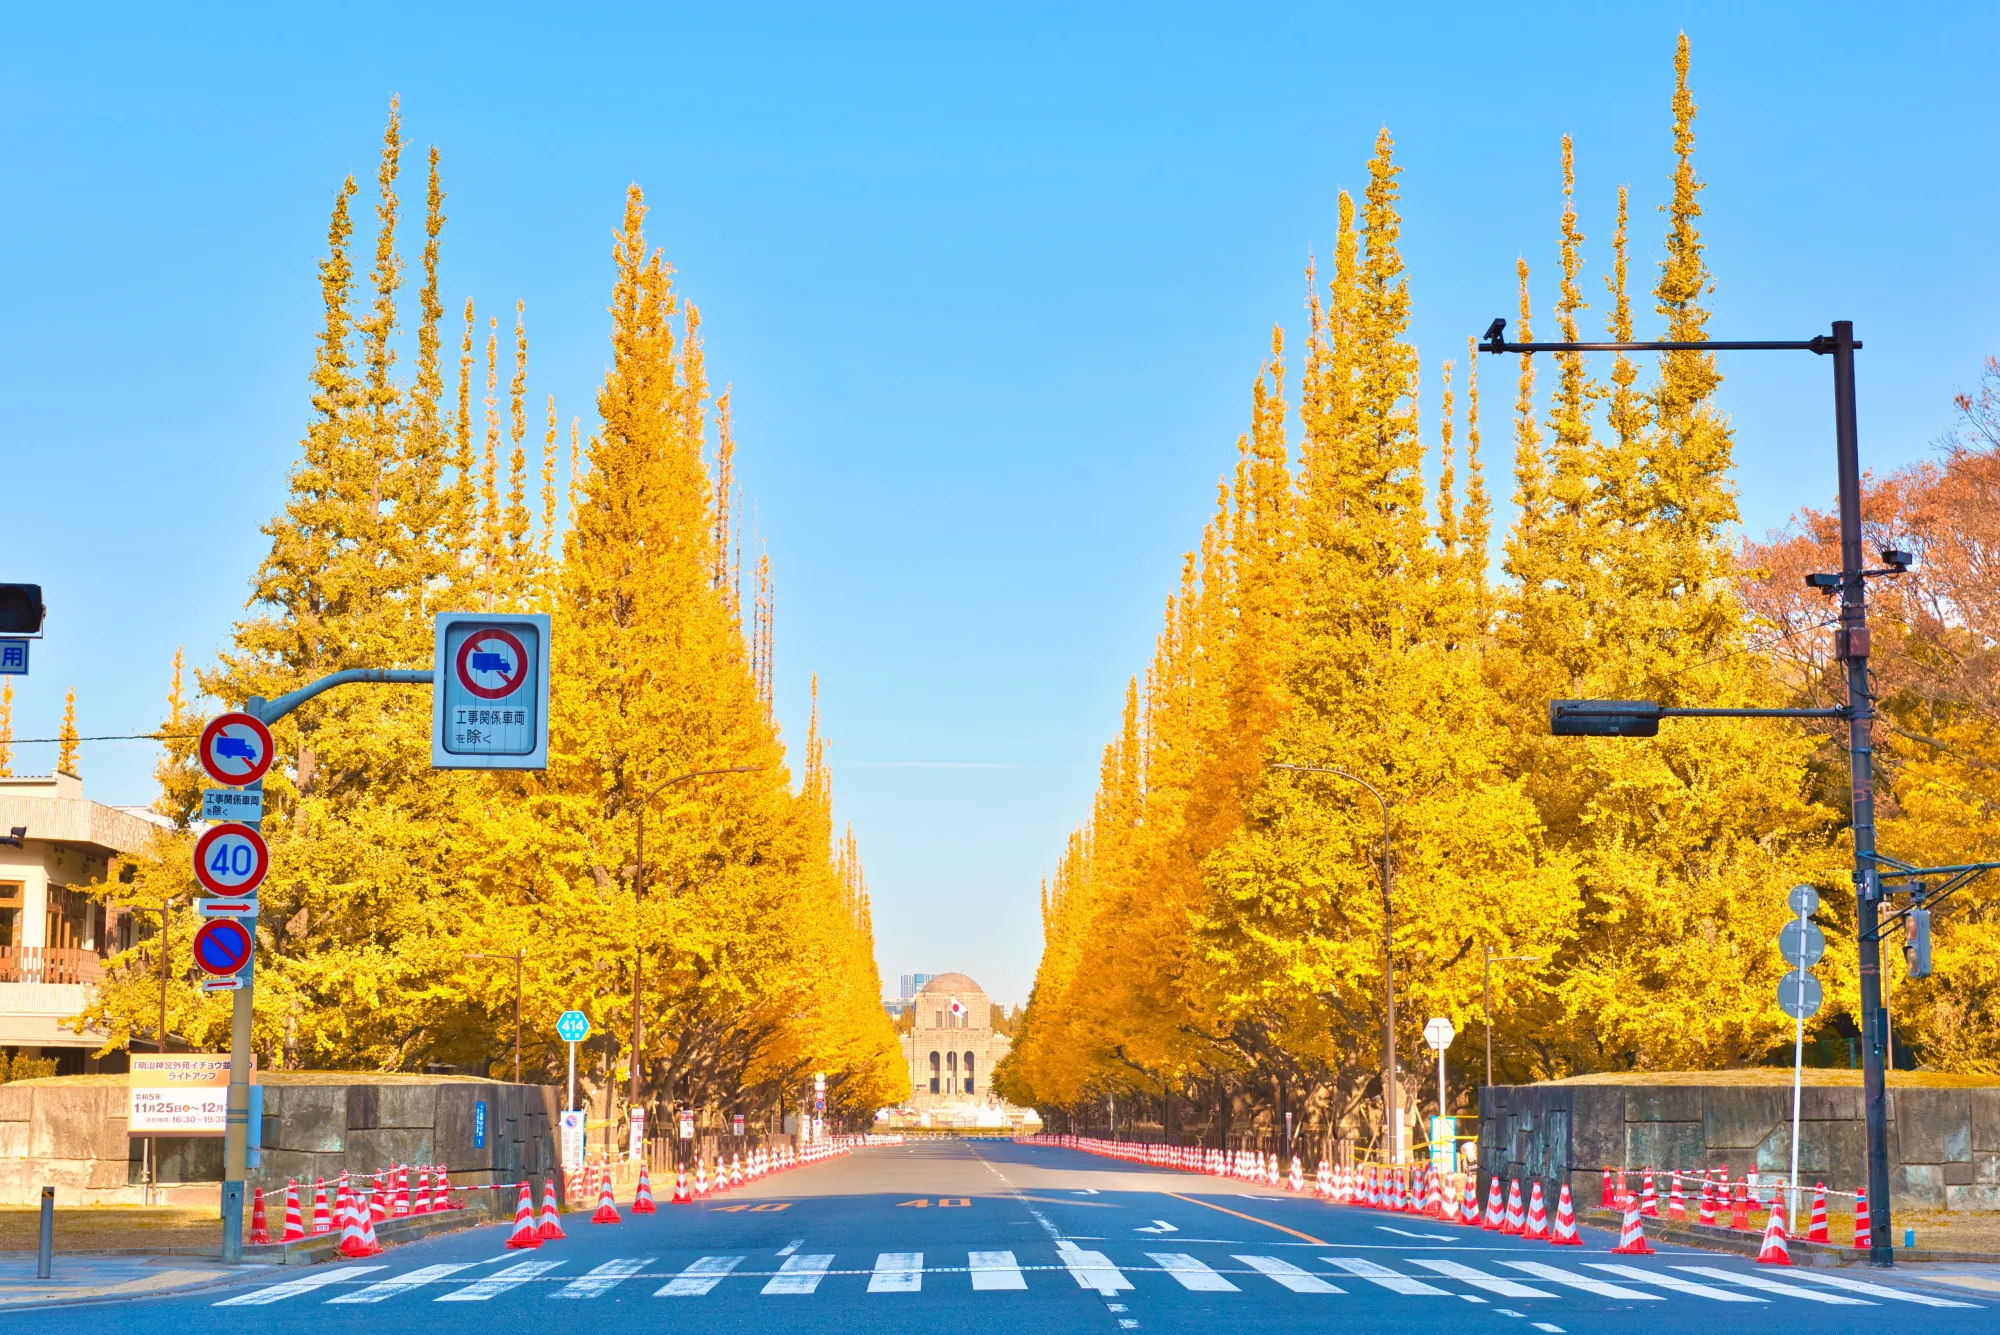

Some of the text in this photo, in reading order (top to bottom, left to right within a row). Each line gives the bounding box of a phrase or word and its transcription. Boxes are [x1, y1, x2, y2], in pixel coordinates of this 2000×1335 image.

[2, 647, 23, 667] 用
[456, 710, 526, 726] 工事関係車両
[456, 729, 492, 744] を除く
[206, 793, 260, 807] 工事関係車両
[206, 805, 228, 816] を除く
[211, 843, 252, 876] 40
[561, 1019, 585, 1032] 414
[134, 1061, 253, 1070] 「明治神宮外苑イチョウ並
[168, 1072, 216, 1080] ライトアップ
[135, 1093, 162, 1101] 令和5年
[708, 1203, 793, 1213] 40
[896, 1198, 972, 1208] 40
